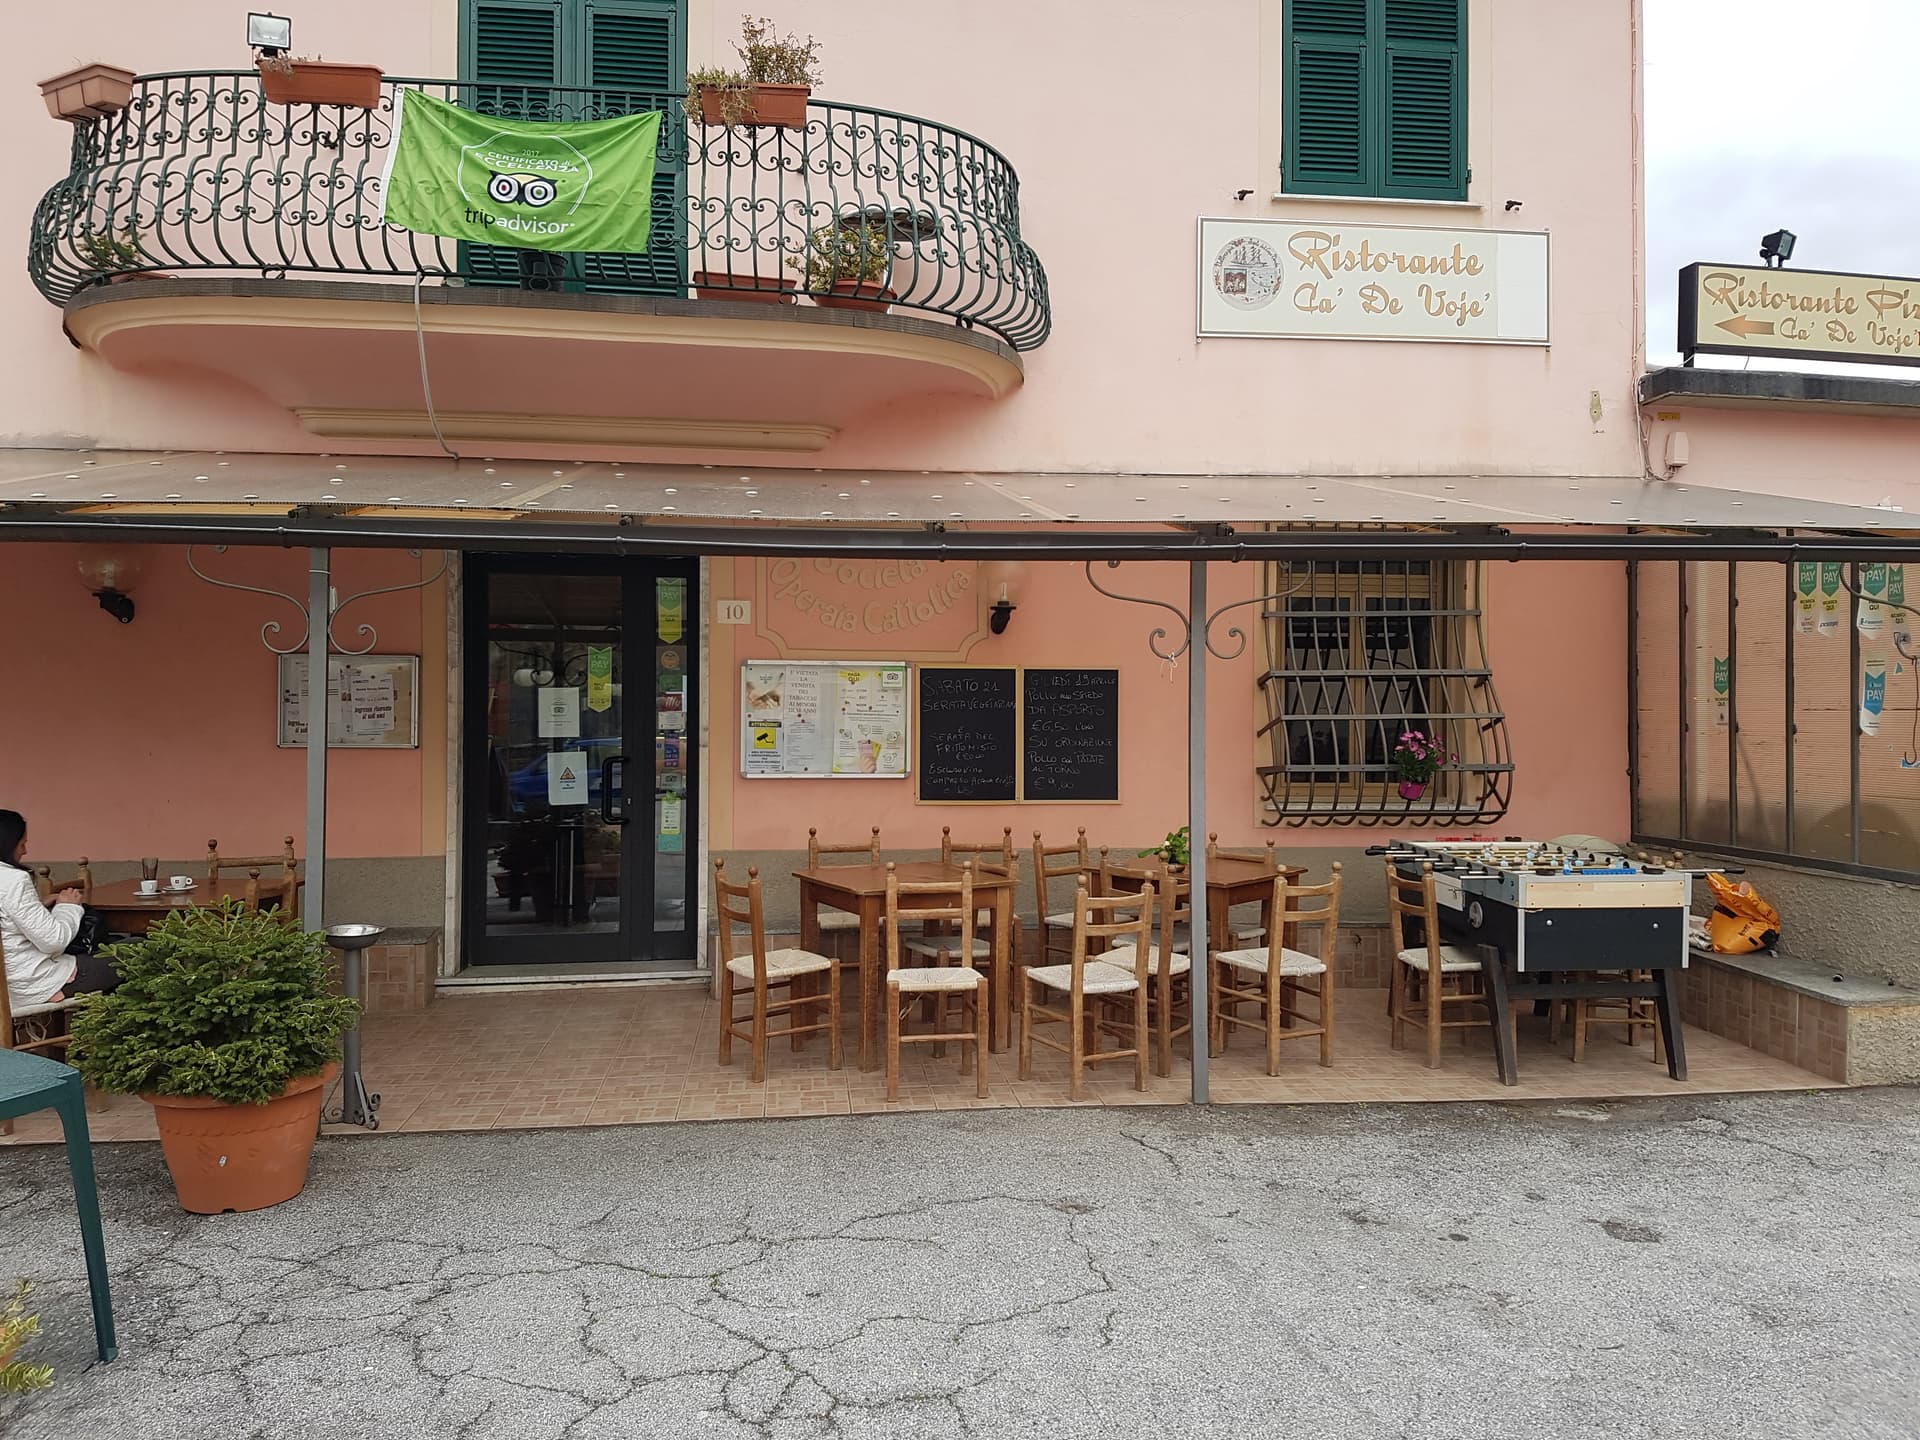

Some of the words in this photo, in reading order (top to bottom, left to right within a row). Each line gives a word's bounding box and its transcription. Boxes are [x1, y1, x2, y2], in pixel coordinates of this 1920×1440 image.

[487, 151, 558, 166] CERTIFICATO
[522, 149, 540, 157] 2017
[474, 152, 579, 173] ECCELLENZA
[465, 207, 570, 234] tripadvisor
[1288, 231, 1484, 280] Ristorante
[1294, 281, 1343, 314] Ca'
[1359, 281, 1403, 314] De
[1703, 272, 1859, 314] Ristorante
[1779, 316, 1815, 341] Ca'
[1826, 319, 1857, 343] De
[1801, 571, 1816, 583] PAY
[1823, 571, 1839, 583] PAY
[1866, 569, 1885, 581] PAY
[1888, 583, 1903, 594] PAY
[863, 569, 972, 635] Cattolica
[725, 604, 744, 619] 10
[1715, 672, 1728, 682] PAY
[1867, 690, 1883, 701] PAY
